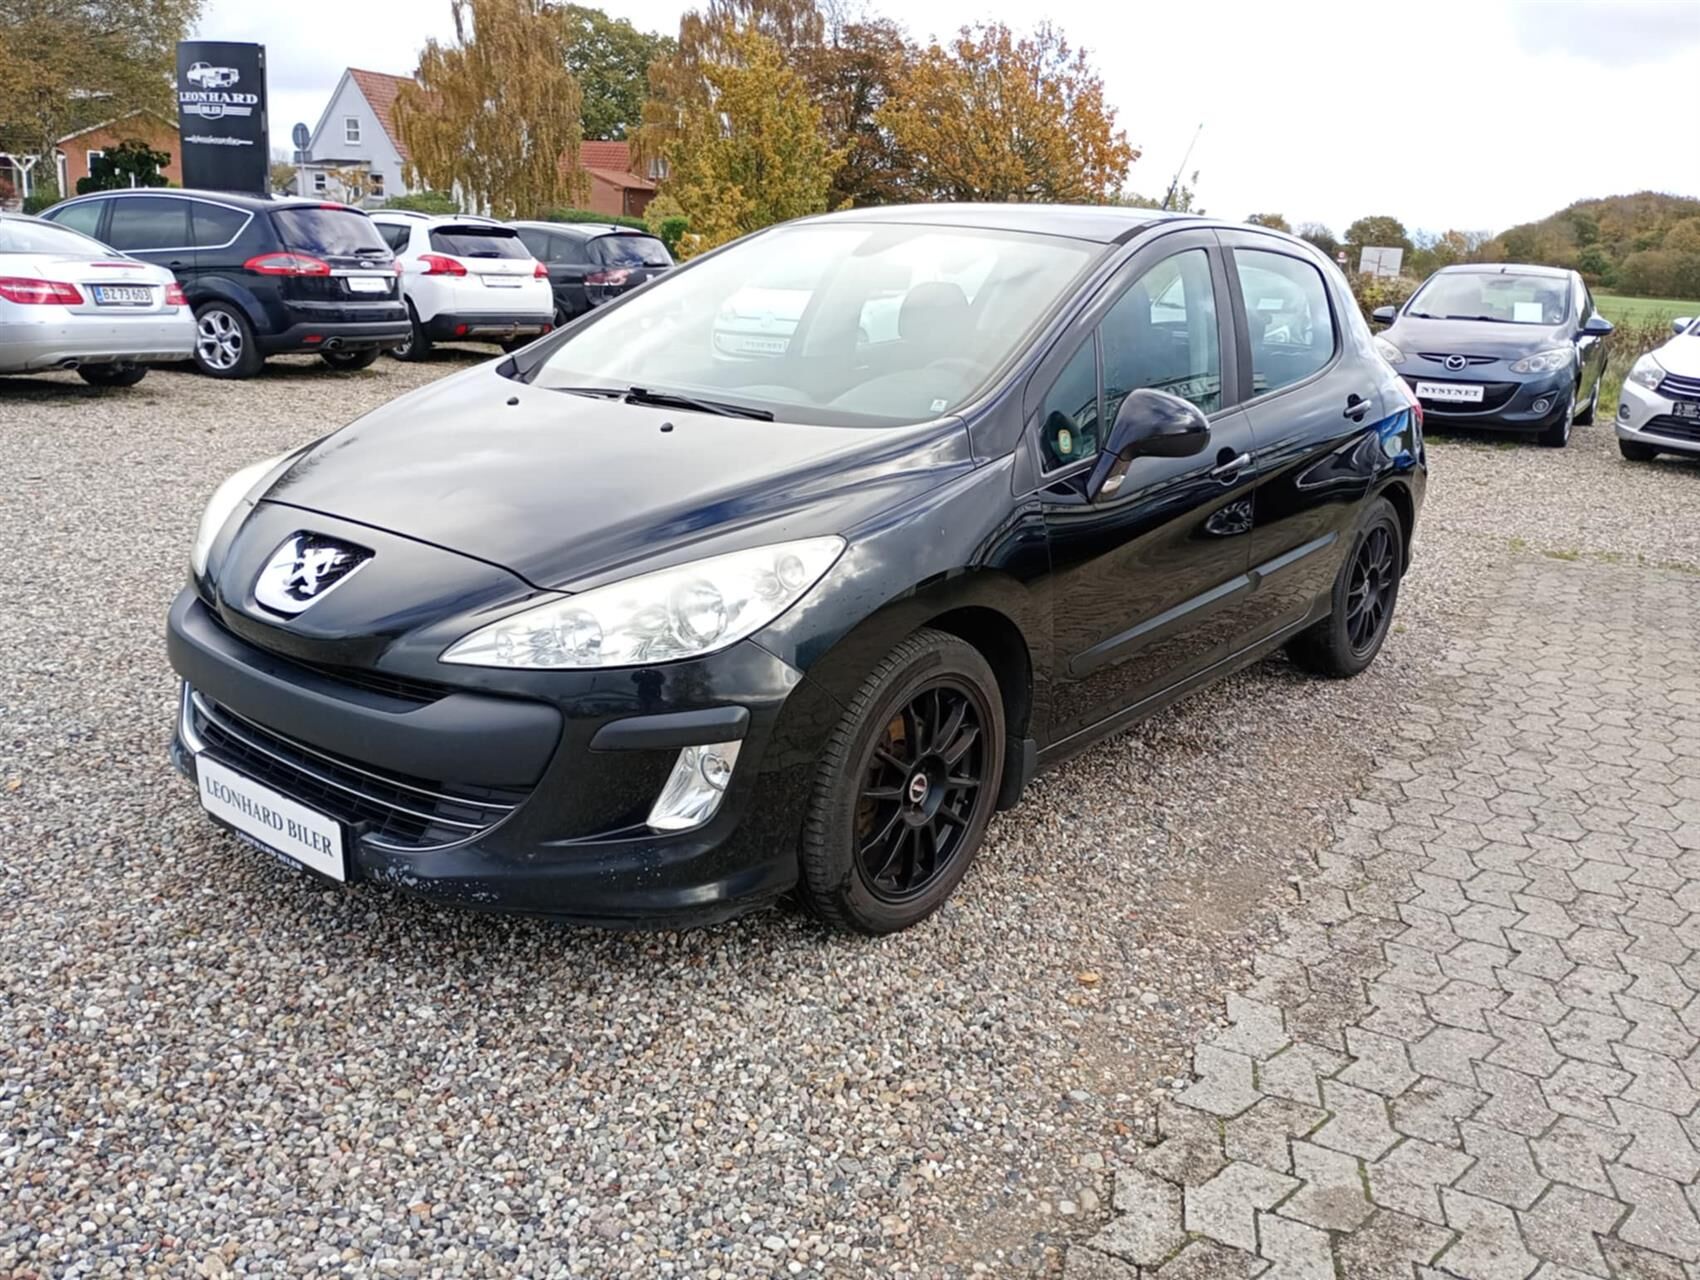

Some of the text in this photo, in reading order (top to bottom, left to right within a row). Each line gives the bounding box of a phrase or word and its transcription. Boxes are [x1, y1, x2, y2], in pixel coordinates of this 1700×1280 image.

[179, 92, 258, 105] LEONHARD
[1421, 387, 1479, 397] NYSYNET
[205, 776, 283, 831] LEONHARD
[287, 819, 334, 857] BILER
